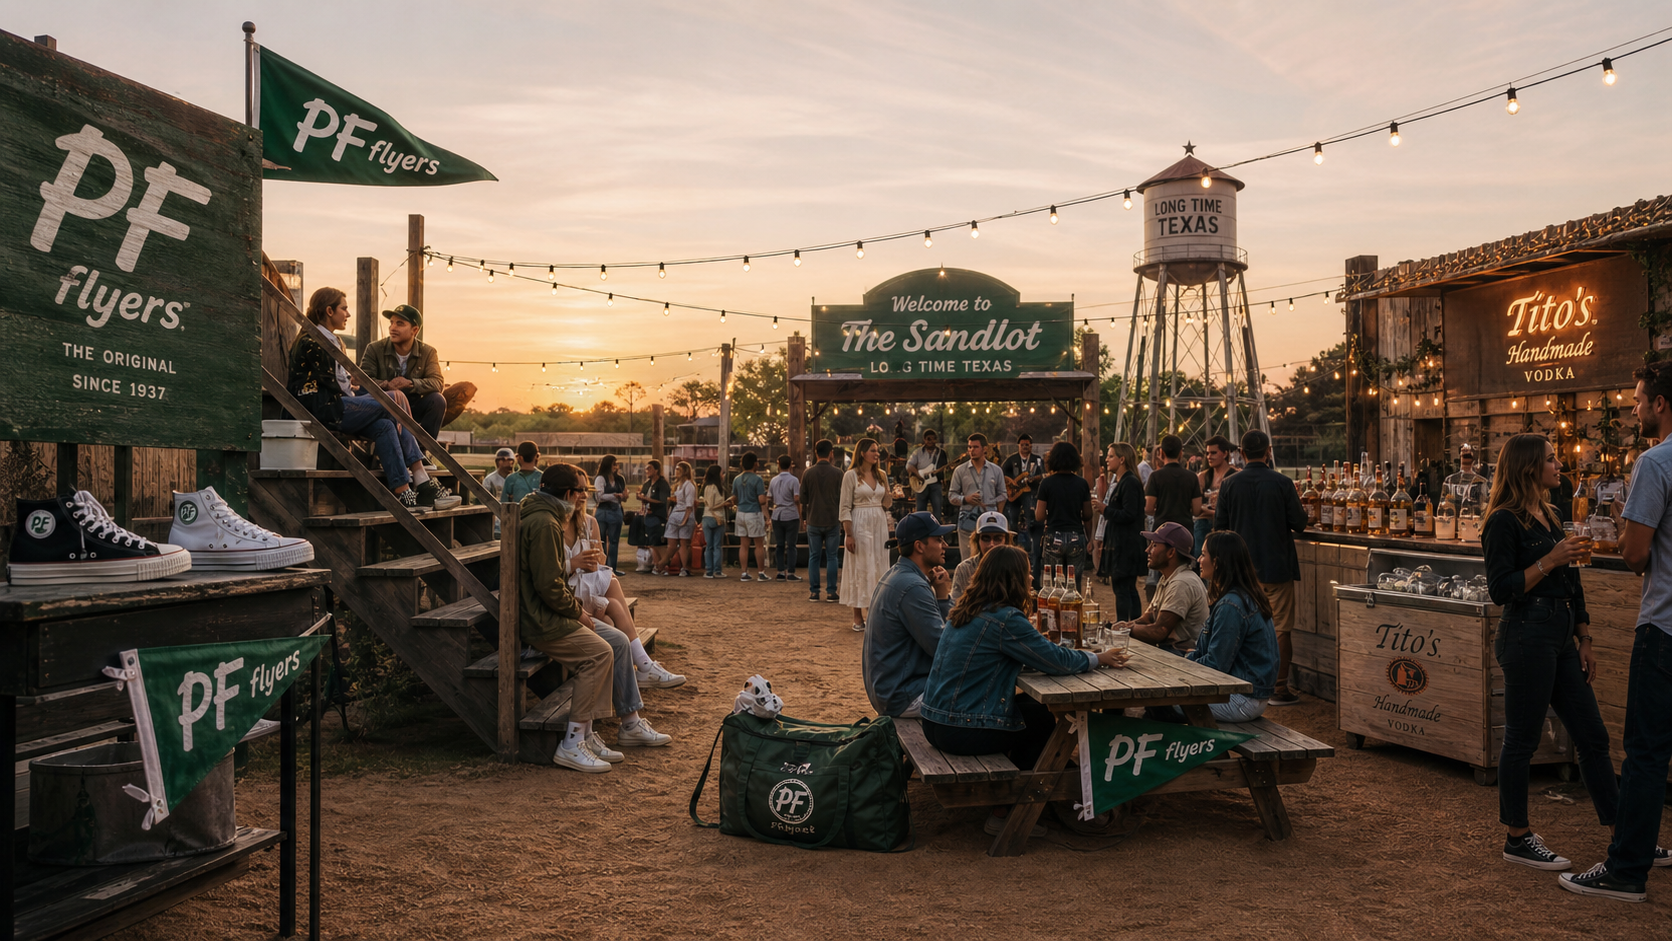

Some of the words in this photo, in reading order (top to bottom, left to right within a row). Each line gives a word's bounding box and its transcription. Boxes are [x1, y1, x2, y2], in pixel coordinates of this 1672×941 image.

[293, 98, 378, 162] PF
[368, 140, 440, 176] flyers
[30, 124, 213, 273] PF
[1155, 198, 1186, 216] LONG
[1191, 198, 1222, 214] TIME
[1158, 215, 1219, 236] TEXAS
[54, 265, 184, 329] flyers
[891, 295, 969, 312] Welcome
[974, 296, 992, 311] to
[840, 319, 896, 352] The
[902, 318, 1043, 352] Sandlot
[1506, 331, 1594, 365] Handmade
[62, 342, 95, 361] THE
[103, 349, 177, 375] ORIGINAL
[870, 361, 912, 373] LOG
[918, 360, 956, 373] TIME
[962, 359, 1012, 372] TEXAS
[72, 374, 121, 394] SINCE
[130, 382, 166, 400] 1937
[1524, 366, 1575, 382] VODKA
[31, 516, 51, 533] PF
[177, 656, 244, 752] PF
[250, 650, 300, 698] flyers
[1372, 694, 1441, 723] Handmade
[1387, 719, 1425, 736] VODKA
[1104, 733, 1163, 782] PF
[1165, 738, 1216, 763] flyers
[775, 786, 808, 815] PF
